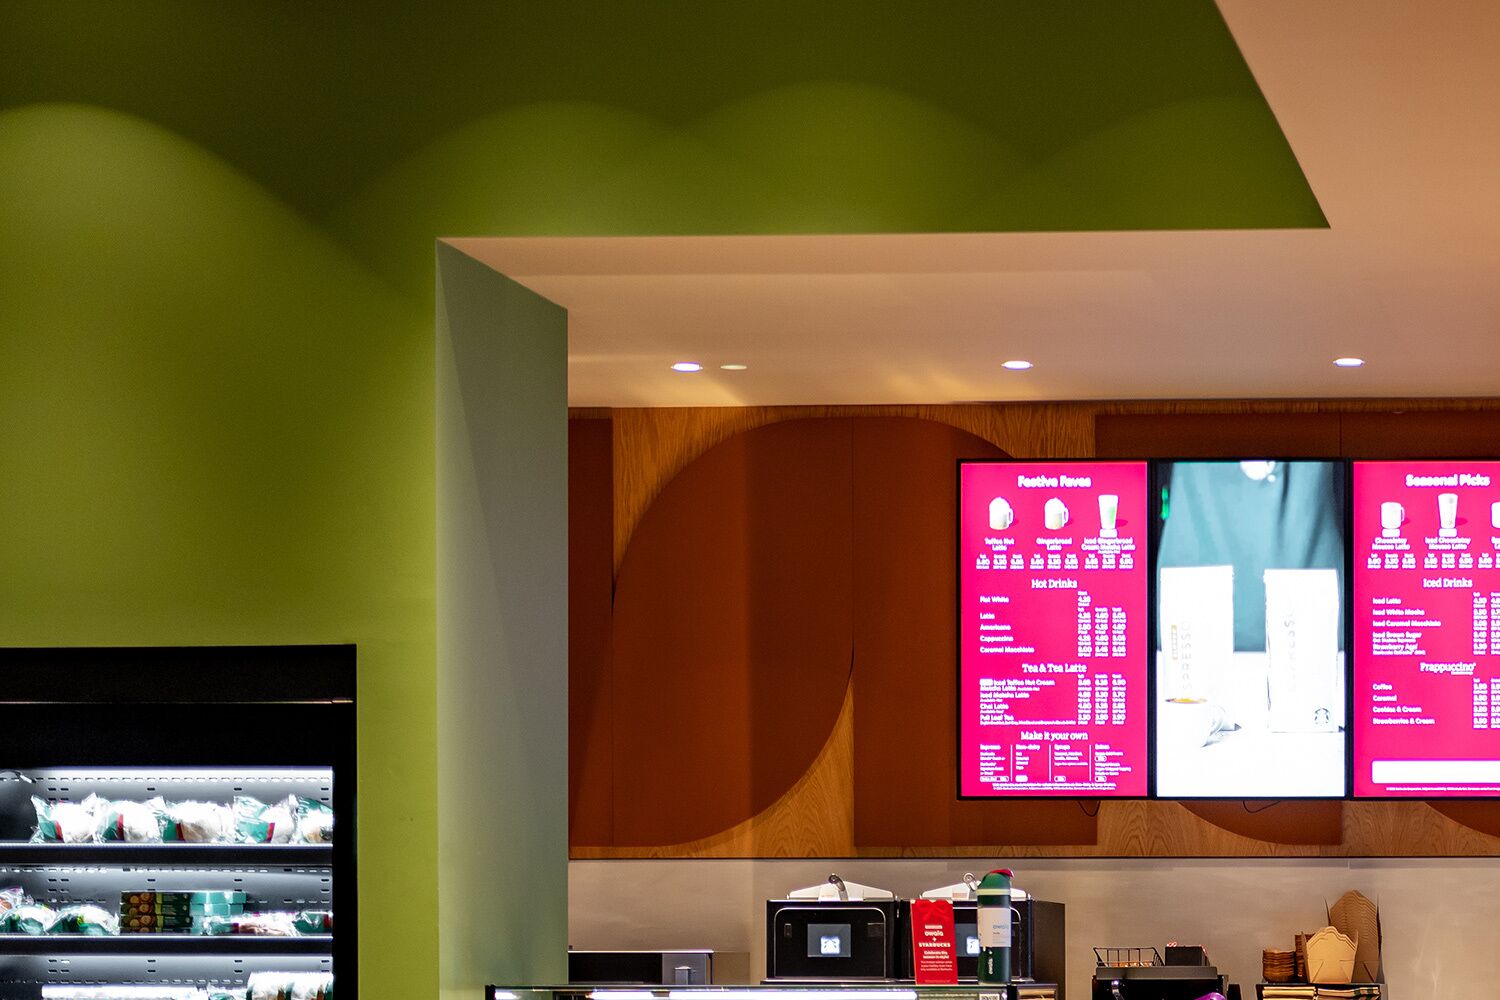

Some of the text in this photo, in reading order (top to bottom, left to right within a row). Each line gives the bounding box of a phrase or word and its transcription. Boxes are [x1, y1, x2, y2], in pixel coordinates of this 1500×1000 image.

[1018, 475, 1091, 487] Festive Faves
[1406, 474, 1490, 486] Seasonal Picks
[1032, 578, 1077, 588] Hot Drinks
[1424, 578, 1472, 587] Iced Drinks
[1022, 664, 1086, 672] Tea & Tea Latte
[1021, 731, 1043, 740] Make
[1051, 733, 1069, 741] your
